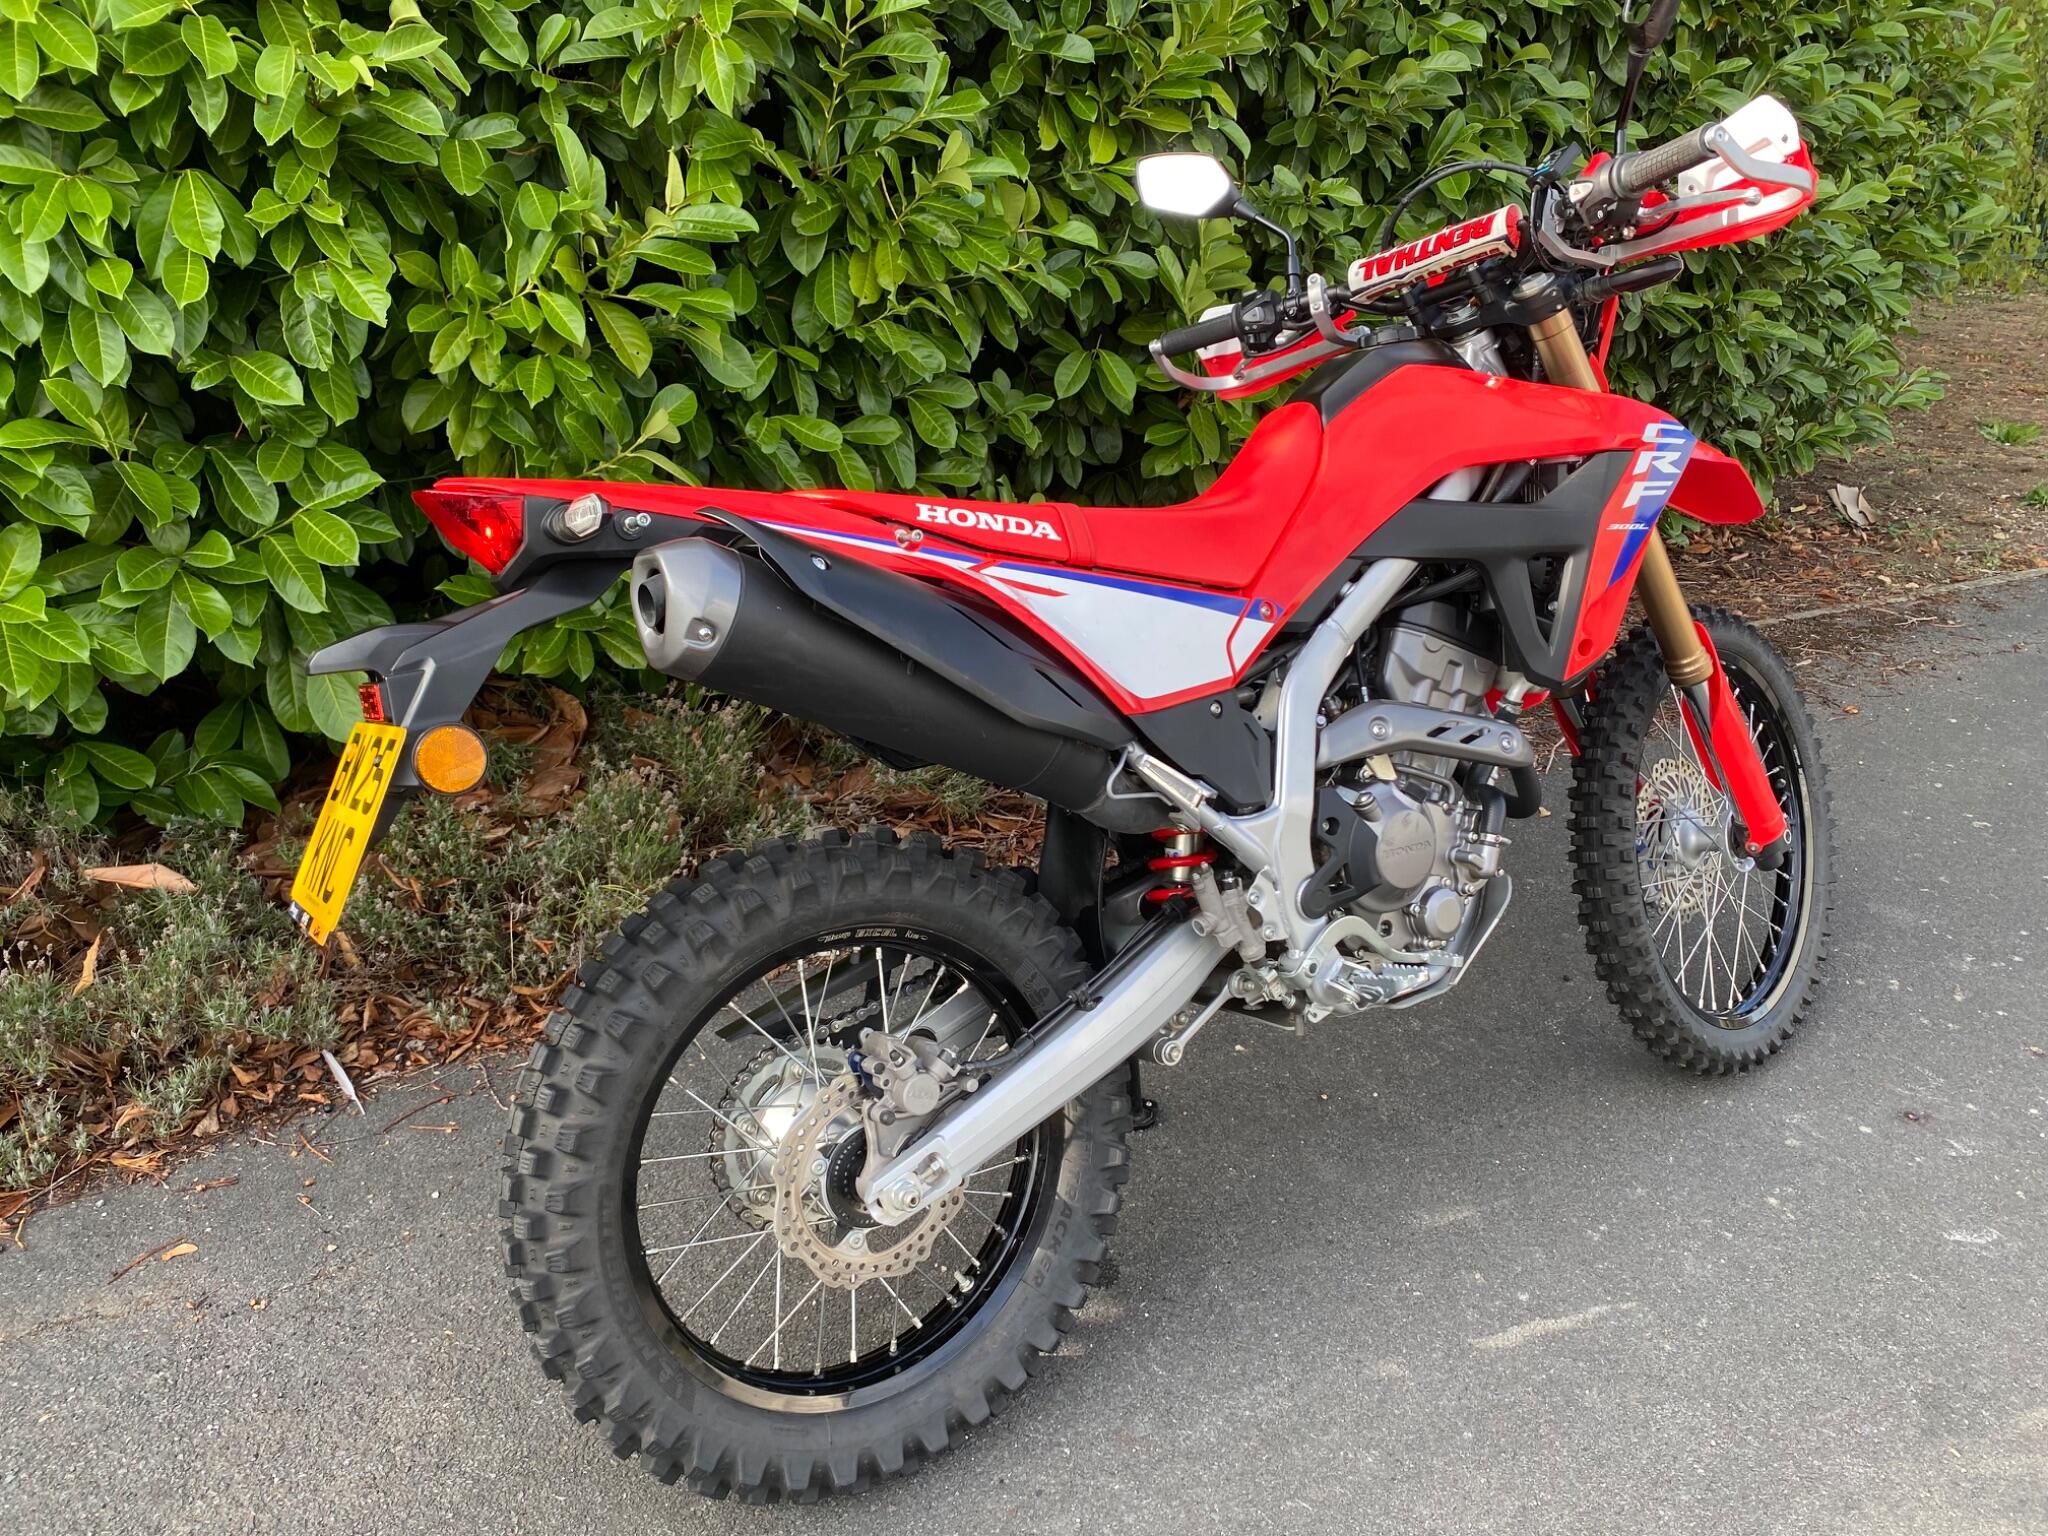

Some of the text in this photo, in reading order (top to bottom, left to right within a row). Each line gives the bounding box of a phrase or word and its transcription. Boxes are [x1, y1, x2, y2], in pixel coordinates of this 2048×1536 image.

[1359, 213, 1497, 281] RENTHAL
[1621, 423, 1687, 509] CRF
[915, 503, 1062, 541] HONDA
[1384, 840, 1432, 858] HONDA
